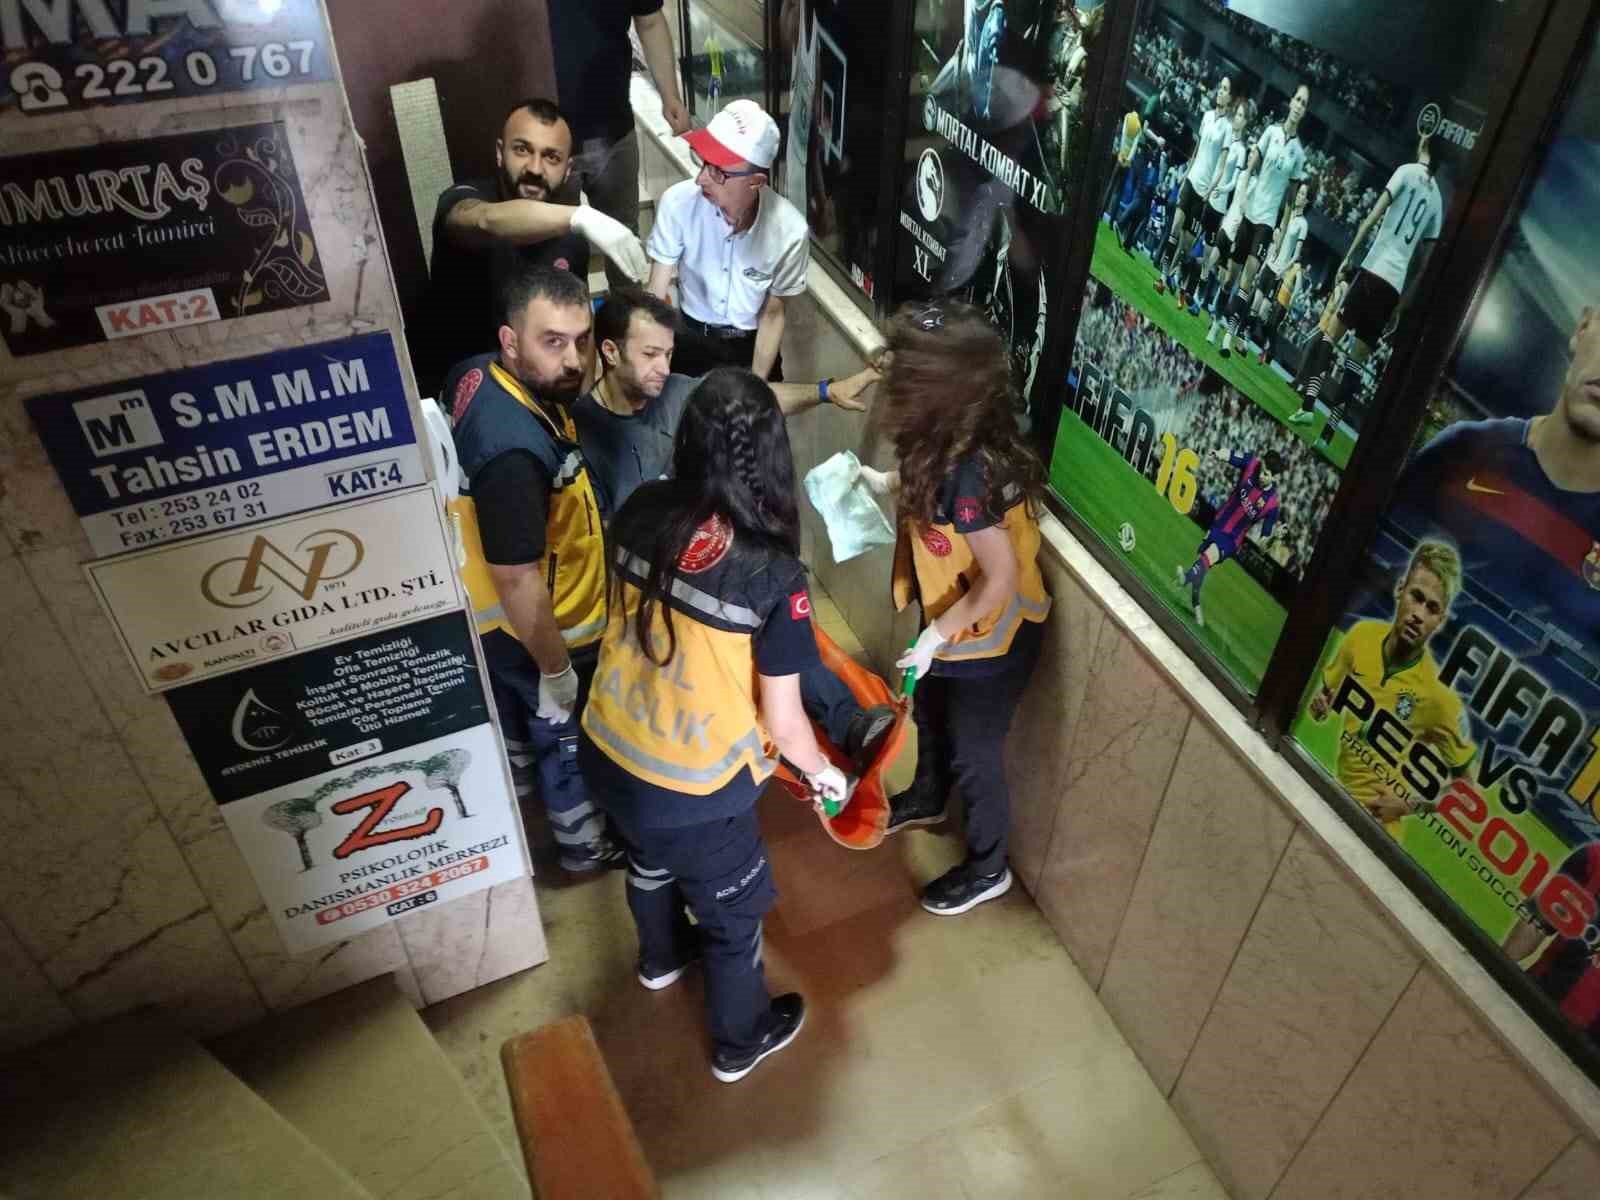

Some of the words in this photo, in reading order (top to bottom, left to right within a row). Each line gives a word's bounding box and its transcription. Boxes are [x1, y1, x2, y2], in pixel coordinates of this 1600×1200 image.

[75, 56, 174, 99] 222
[185, 51, 217, 87] 0
[229, 40, 314, 81] 767
[936, 106, 978, 161] MORTAL
[979, 139, 1030, 197] KOMBAT
[1029, 176, 1048, 214] XL
[900, 209, 922, 241] MORTAL
[922, 229, 946, 263] KOMBAT
[1394, 188, 1427, 245] 19
[913, 245, 932, 283] XL
[107, 294, 211, 332] KAT:2
[169, 357, 370, 429] S.M.M.M
[91, 446, 241, 499] Tahsin
[248, 407, 393, 467] ERDEM
[1072, 359, 1155, 477] FIFA
[1155, 431, 1200, 514] 16
[159, 495, 201, 517] 253
[205, 487, 232, 508] 24
[236, 481, 264, 501] 02
[327, 461, 403, 497] KAT:4
[168, 513, 209, 536] 253
[213, 507, 239, 526] 67
[244, 500, 268, 519] 31
[150, 619, 266, 661] AVCILAR
[272, 601, 335, 627] GIDA
[341, 586, 396, 609] LTD.
[333, 664, 361, 677] Ofis
[334, 655, 352, 665] Ev
[400, 648, 452, 669] Temizlik
[296, 692, 339, 710] Koltuk
[341, 686, 358, 697] ve
[360, 672, 410, 693] Mobilya
[309, 706, 362, 727] Temizlik
[364, 687, 423, 711] Personeli
[425, 674, 466, 695] Temini
[348, 696, 365, 705] ve
[379, 697, 432, 717] Toplama
[1437, 624, 1587, 777] FIFA
[383, 706, 430, 726] Hizmeti
[1332, 674, 1449, 801] PES
[1340, 730, 1373, 767] PRO
[1477, 736, 1538, 815] VS
[1435, 780, 1597, 939] 2016
